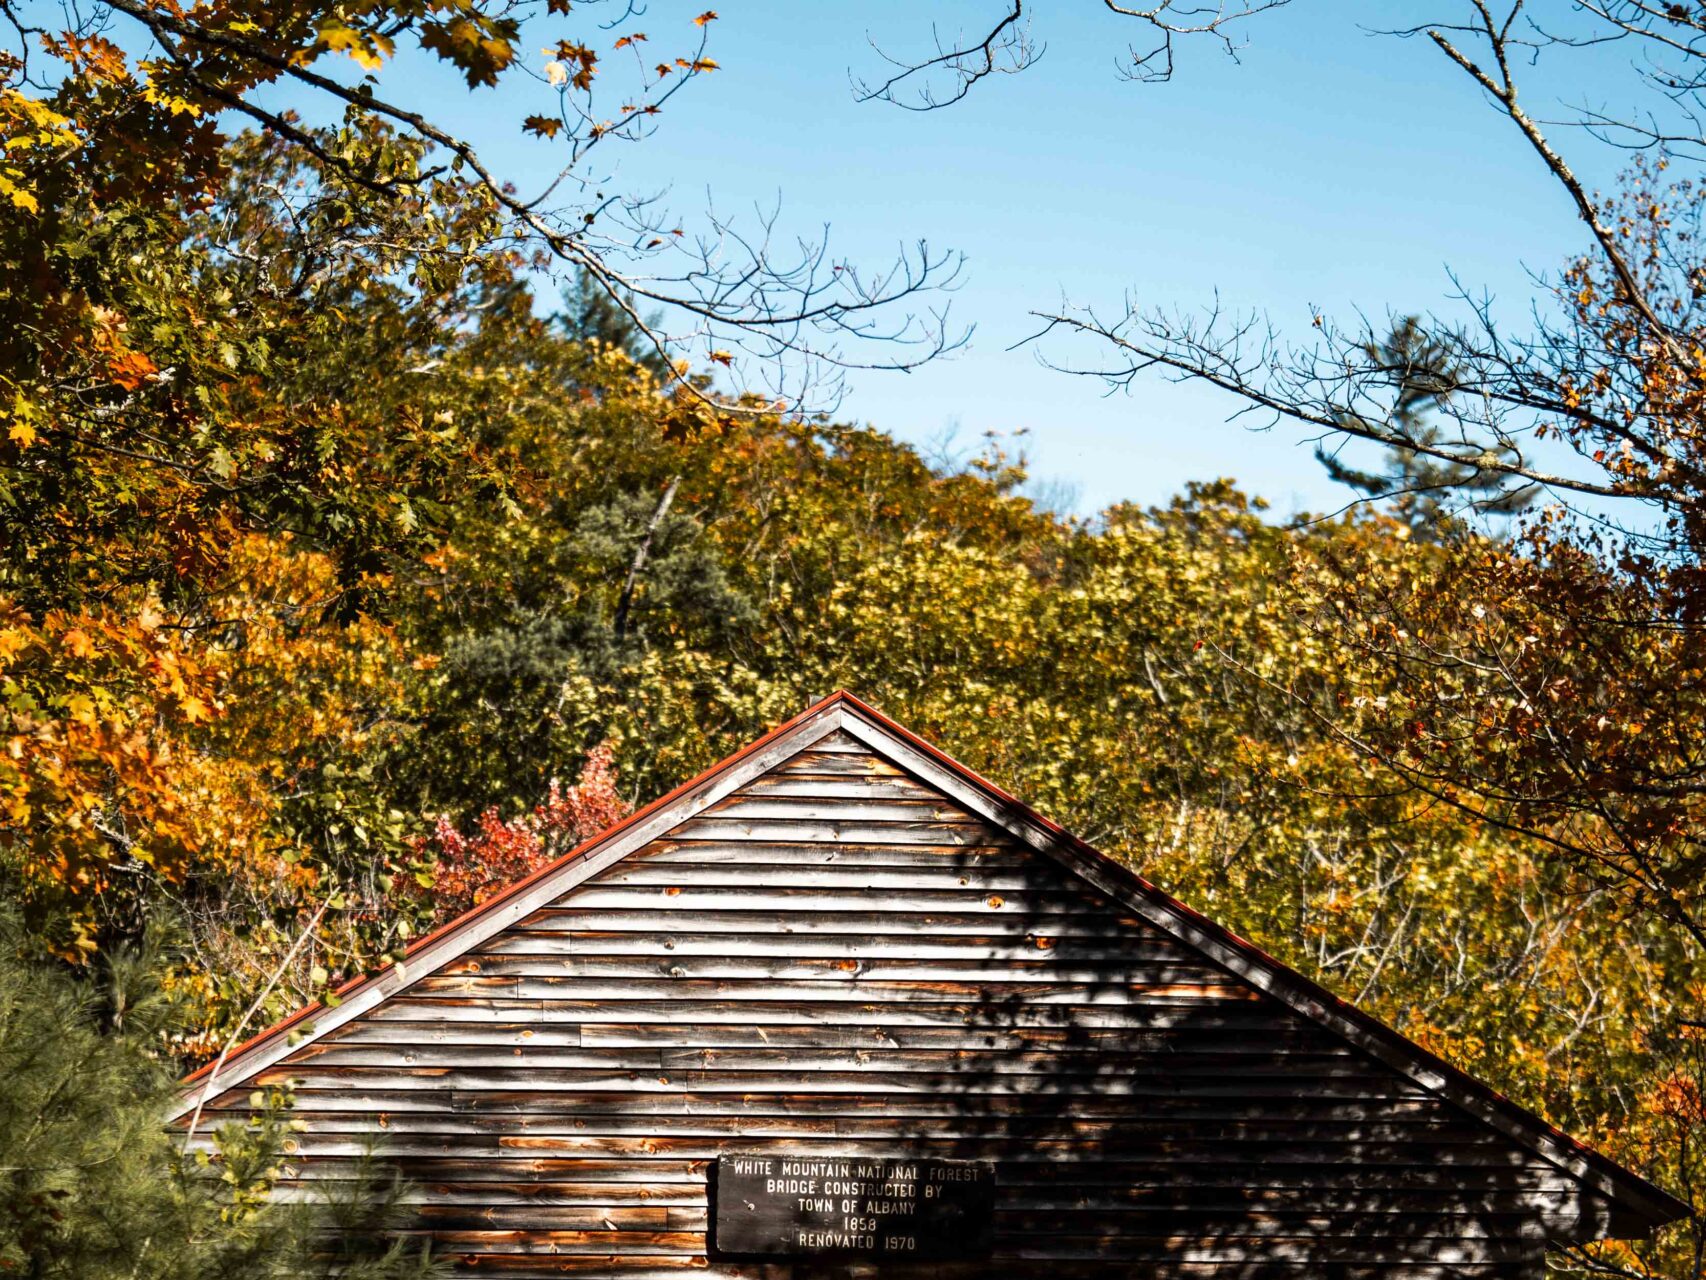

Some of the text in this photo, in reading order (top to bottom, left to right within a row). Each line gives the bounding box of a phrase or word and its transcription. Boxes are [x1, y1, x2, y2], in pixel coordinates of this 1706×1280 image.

[734, 1162, 979, 1182] WHITE MOUNTAIN NATIONAL FOREST
[767, 1180, 943, 1199] BRIDGE CONSTRUCTED BY
[799, 1199, 916, 1215] TOWN OF ALBANY
[844, 1218, 876, 1232] 1858
[800, 1234, 915, 1250] RENOVATED 1970
